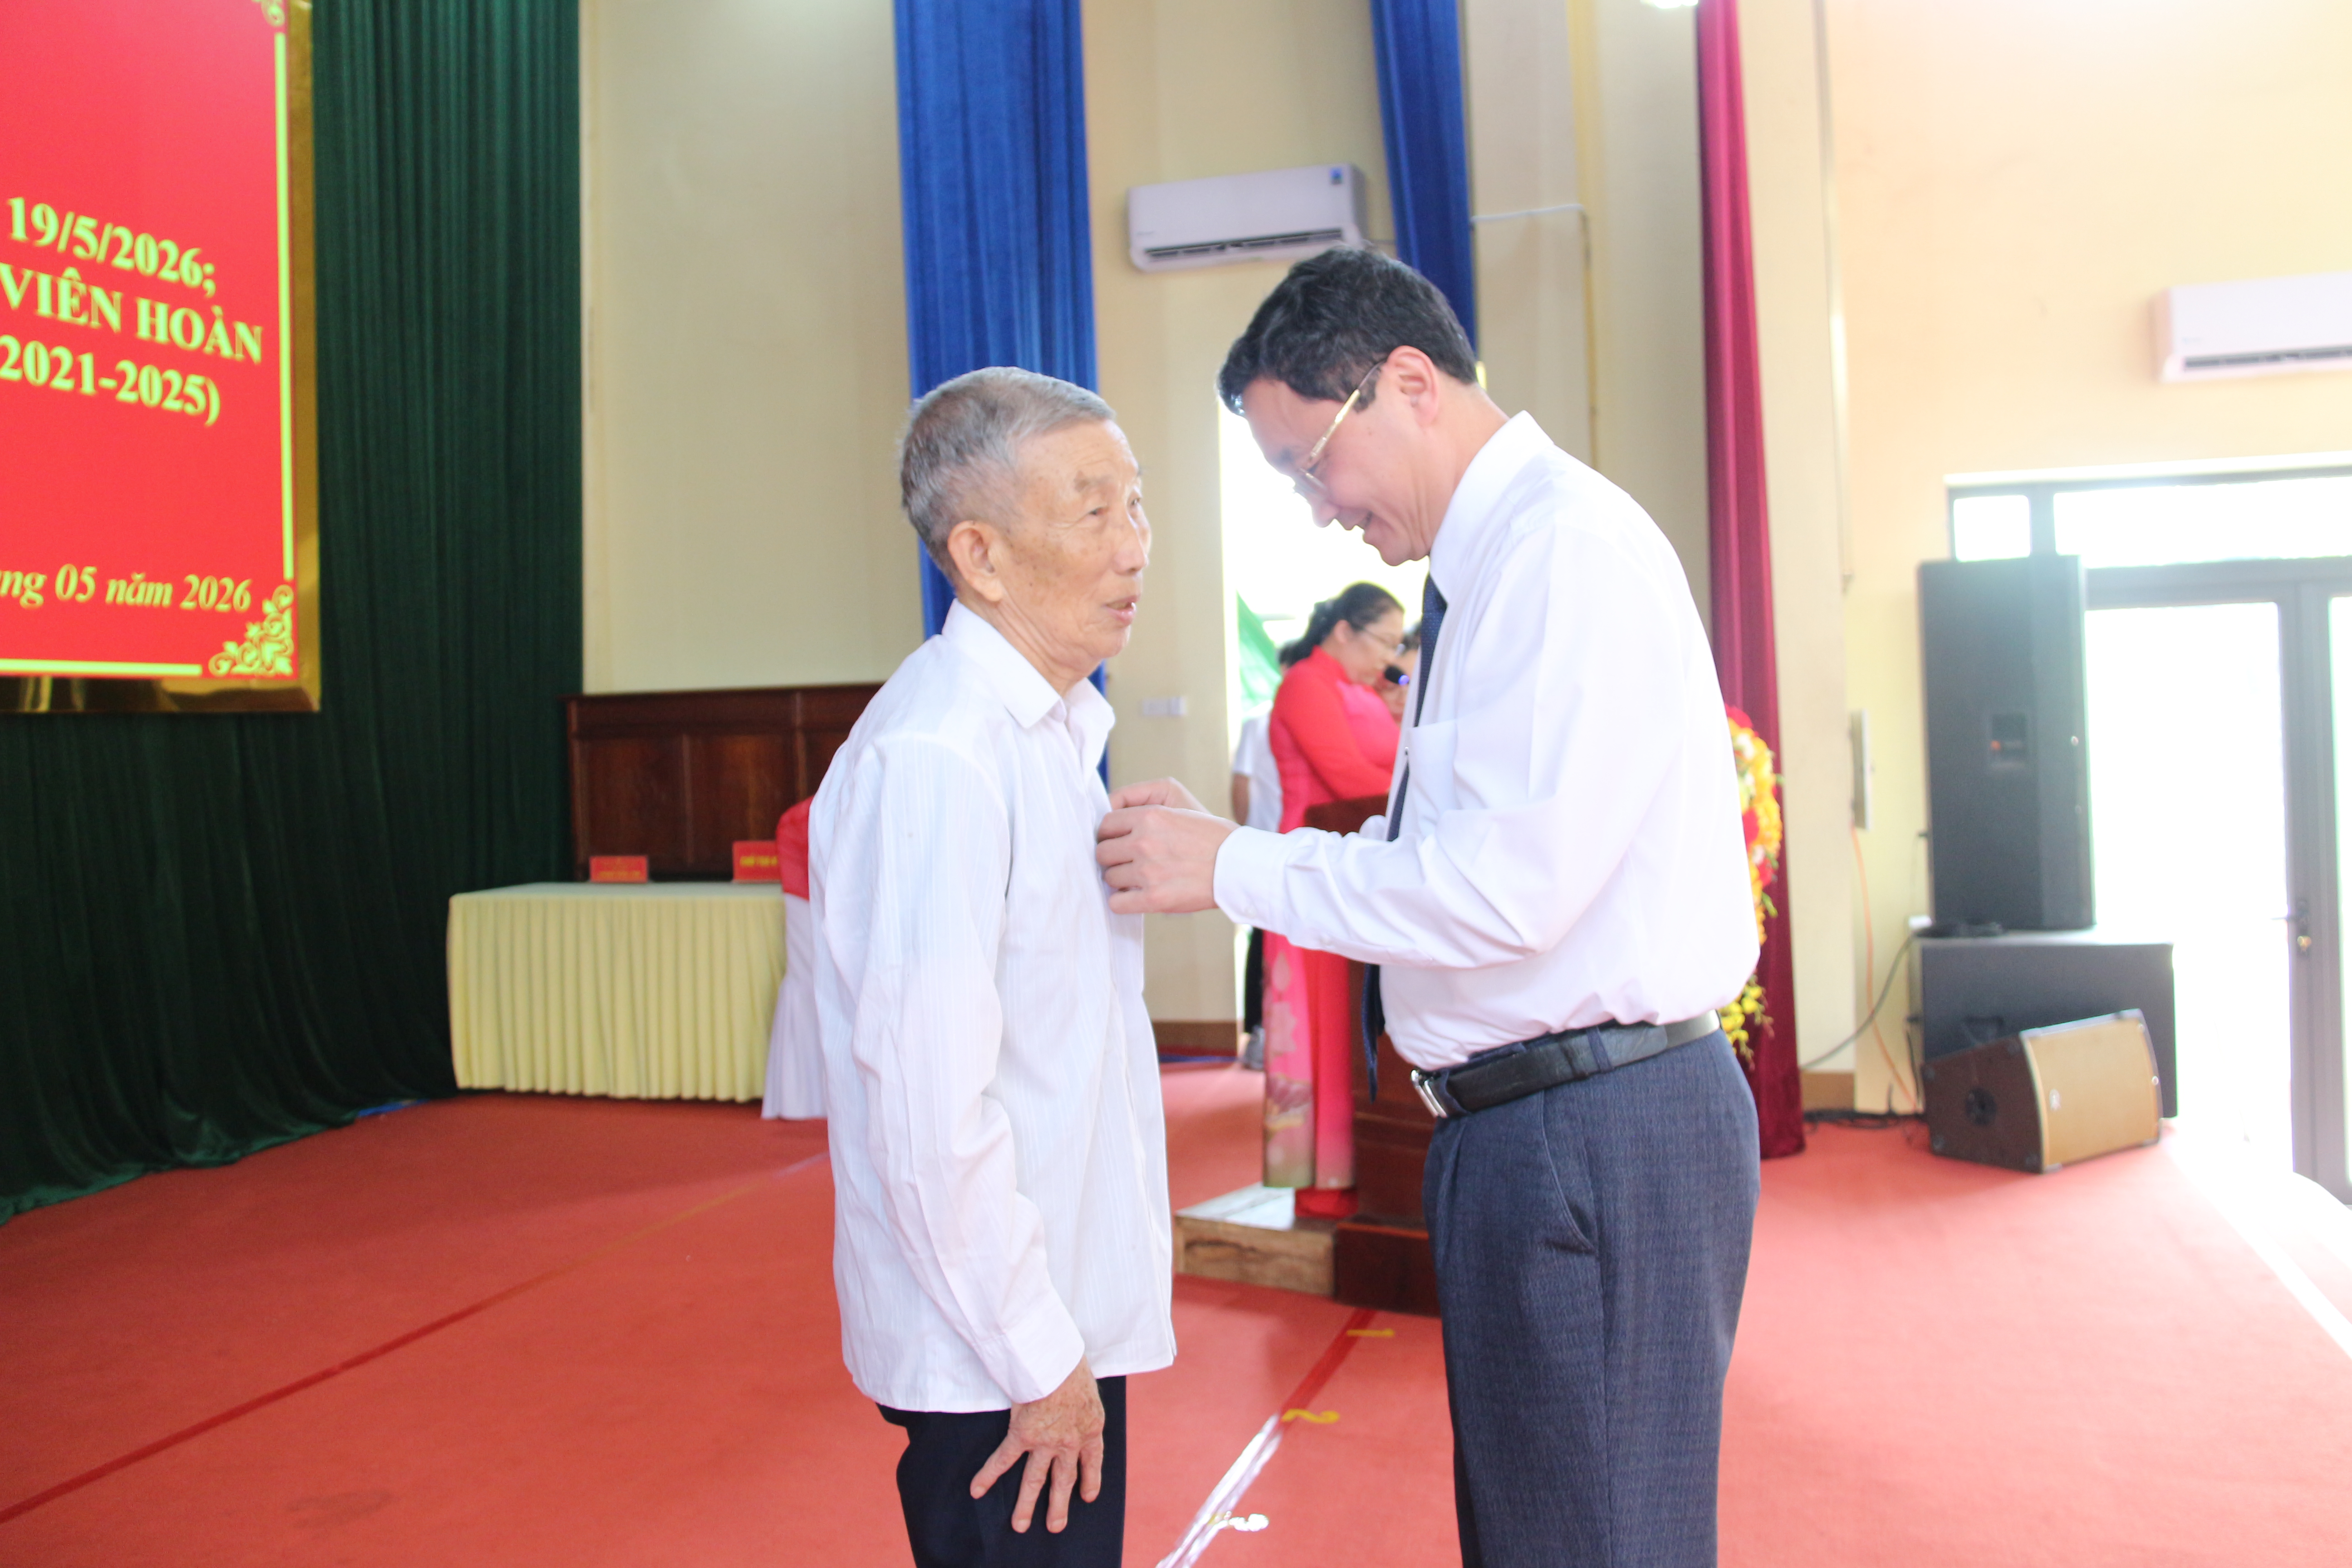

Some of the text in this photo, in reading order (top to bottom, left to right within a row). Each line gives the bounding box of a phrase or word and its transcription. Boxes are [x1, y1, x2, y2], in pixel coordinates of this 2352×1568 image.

[7, 196, 217, 299] 19/5/2026;
[0, 262, 263, 365] VIÊN HOÀN
[0, 334, 221, 427] 2021-2025)
[0, 563, 252, 612] ng 05 năm 2026
